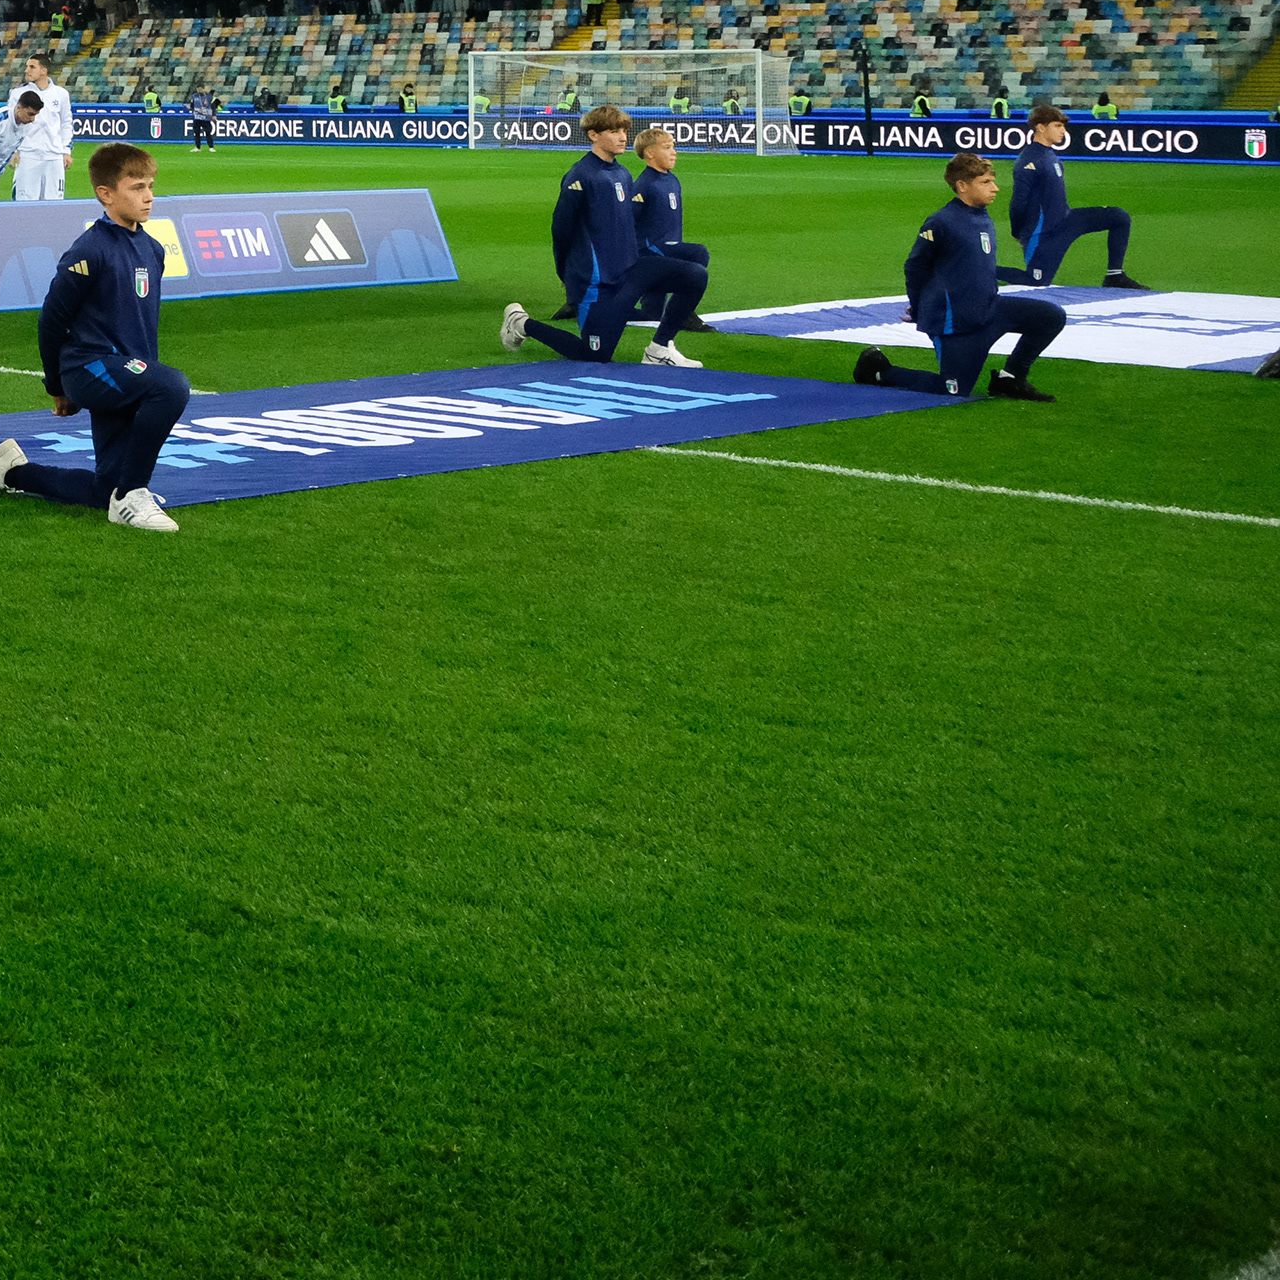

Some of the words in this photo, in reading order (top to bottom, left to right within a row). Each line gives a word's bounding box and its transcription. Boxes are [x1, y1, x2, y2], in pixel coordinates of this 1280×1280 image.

[72, 118, 129, 136] CALCIO
[184, 119, 304, 138] FDERAZIONE
[312, 120, 394, 139] ITALIANA
[402, 120, 484, 140] GIUOCO
[493, 121, 572, 141] CALCIO
[828, 124, 944, 148] ITAIANA
[1084, 128, 1199, 153] CALCIO
[220, 227, 271, 258] TIM
